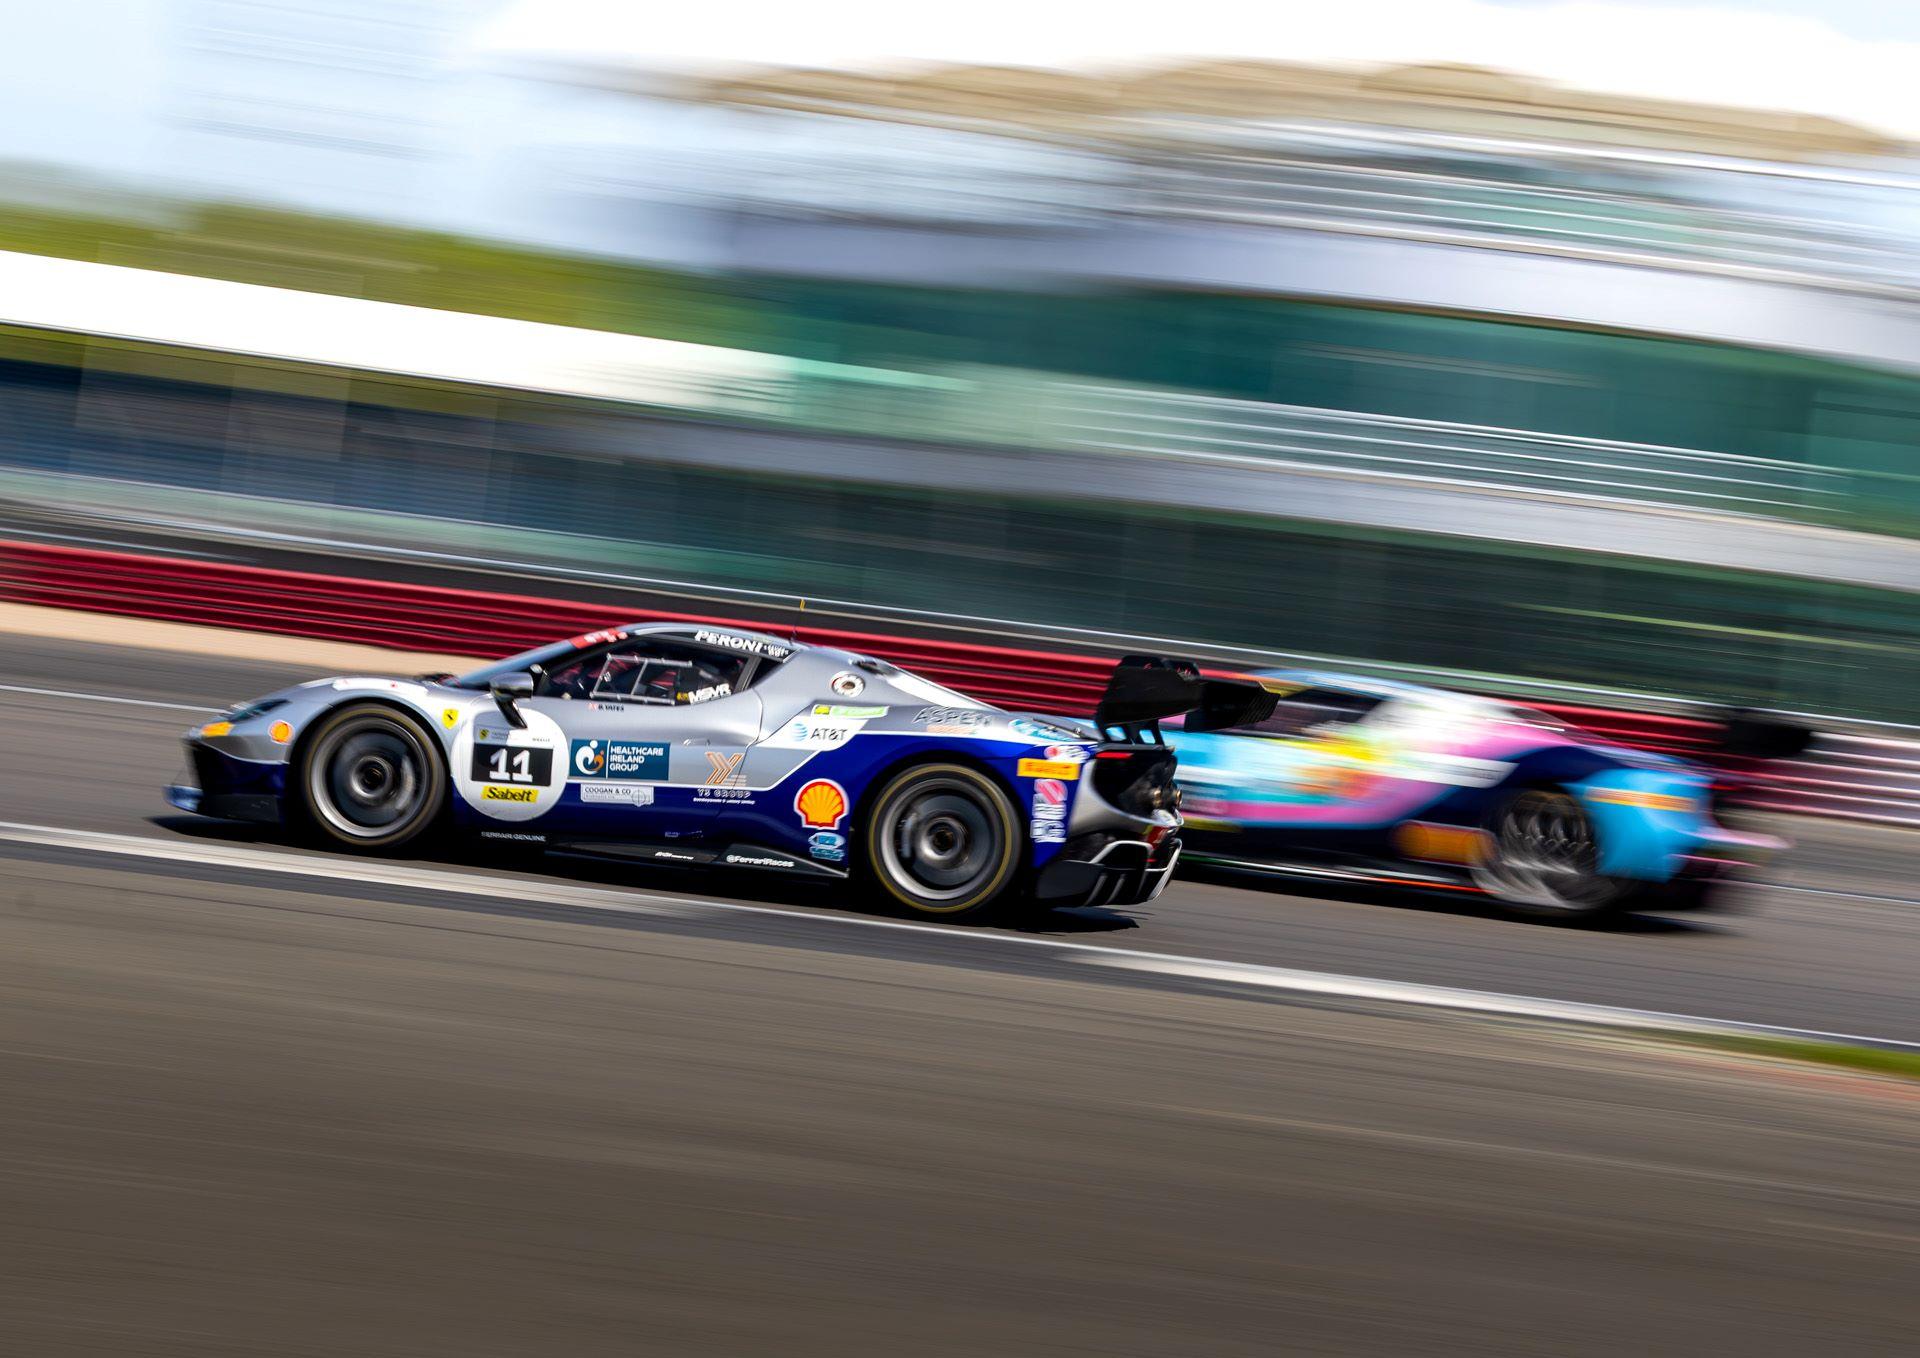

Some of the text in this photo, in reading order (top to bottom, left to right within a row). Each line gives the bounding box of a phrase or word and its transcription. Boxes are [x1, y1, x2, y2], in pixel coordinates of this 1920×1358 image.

[694, 630, 763, 653] PERONI
[811, 728, 848, 741] AT&T
[610, 746, 664, 757] HEALTHCARE
[489, 748, 533, 783] 11
[610, 755, 645, 765] IRELAND
[609, 763, 639, 772] GROUP
[486, 786, 533, 802] Sabelt
[585, 787, 613, 795] COOGAN
[622, 788, 632, 796] CO
[713, 789, 751, 799] GROUP
[513, 833, 546, 842] GENUINE
[726, 854, 795, 868] @FerrariRaces
